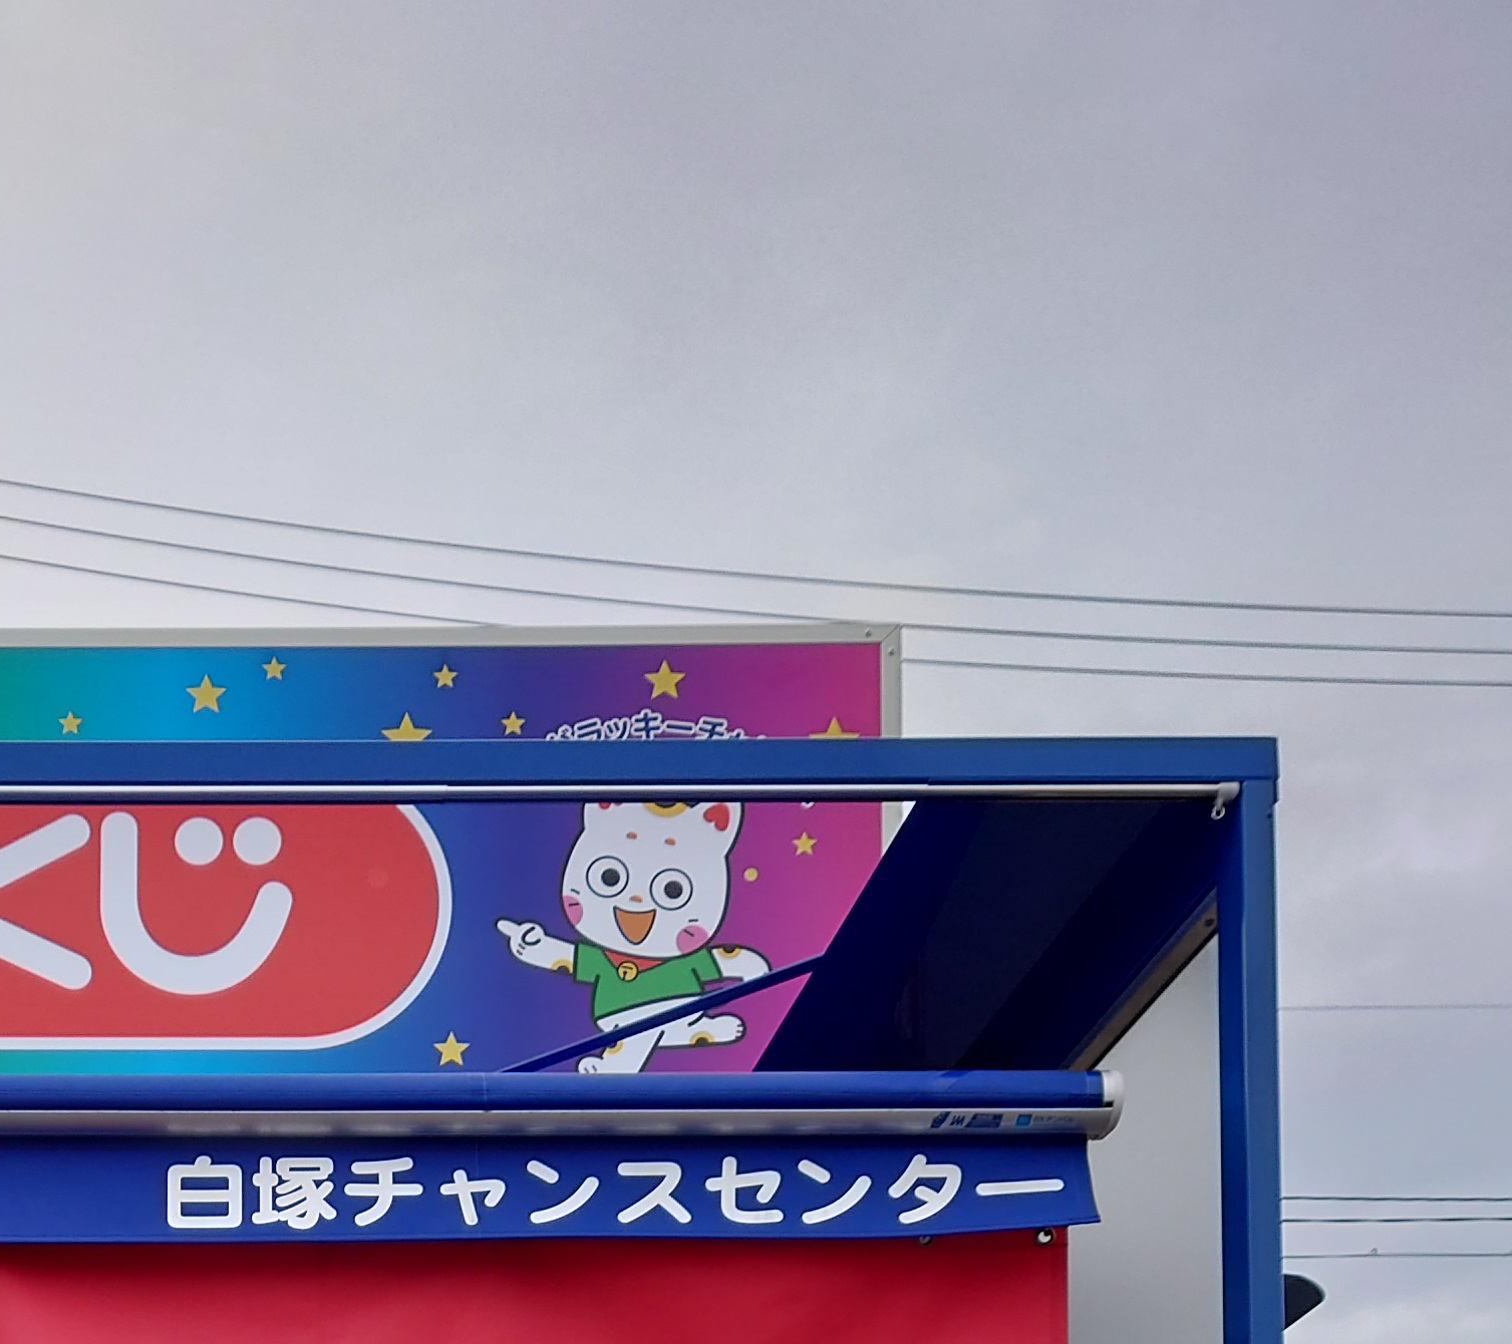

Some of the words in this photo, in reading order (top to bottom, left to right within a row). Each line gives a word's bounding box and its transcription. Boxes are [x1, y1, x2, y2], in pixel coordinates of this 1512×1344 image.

[166, 1154, 1066, 1229] 白塚チャンスセンター
